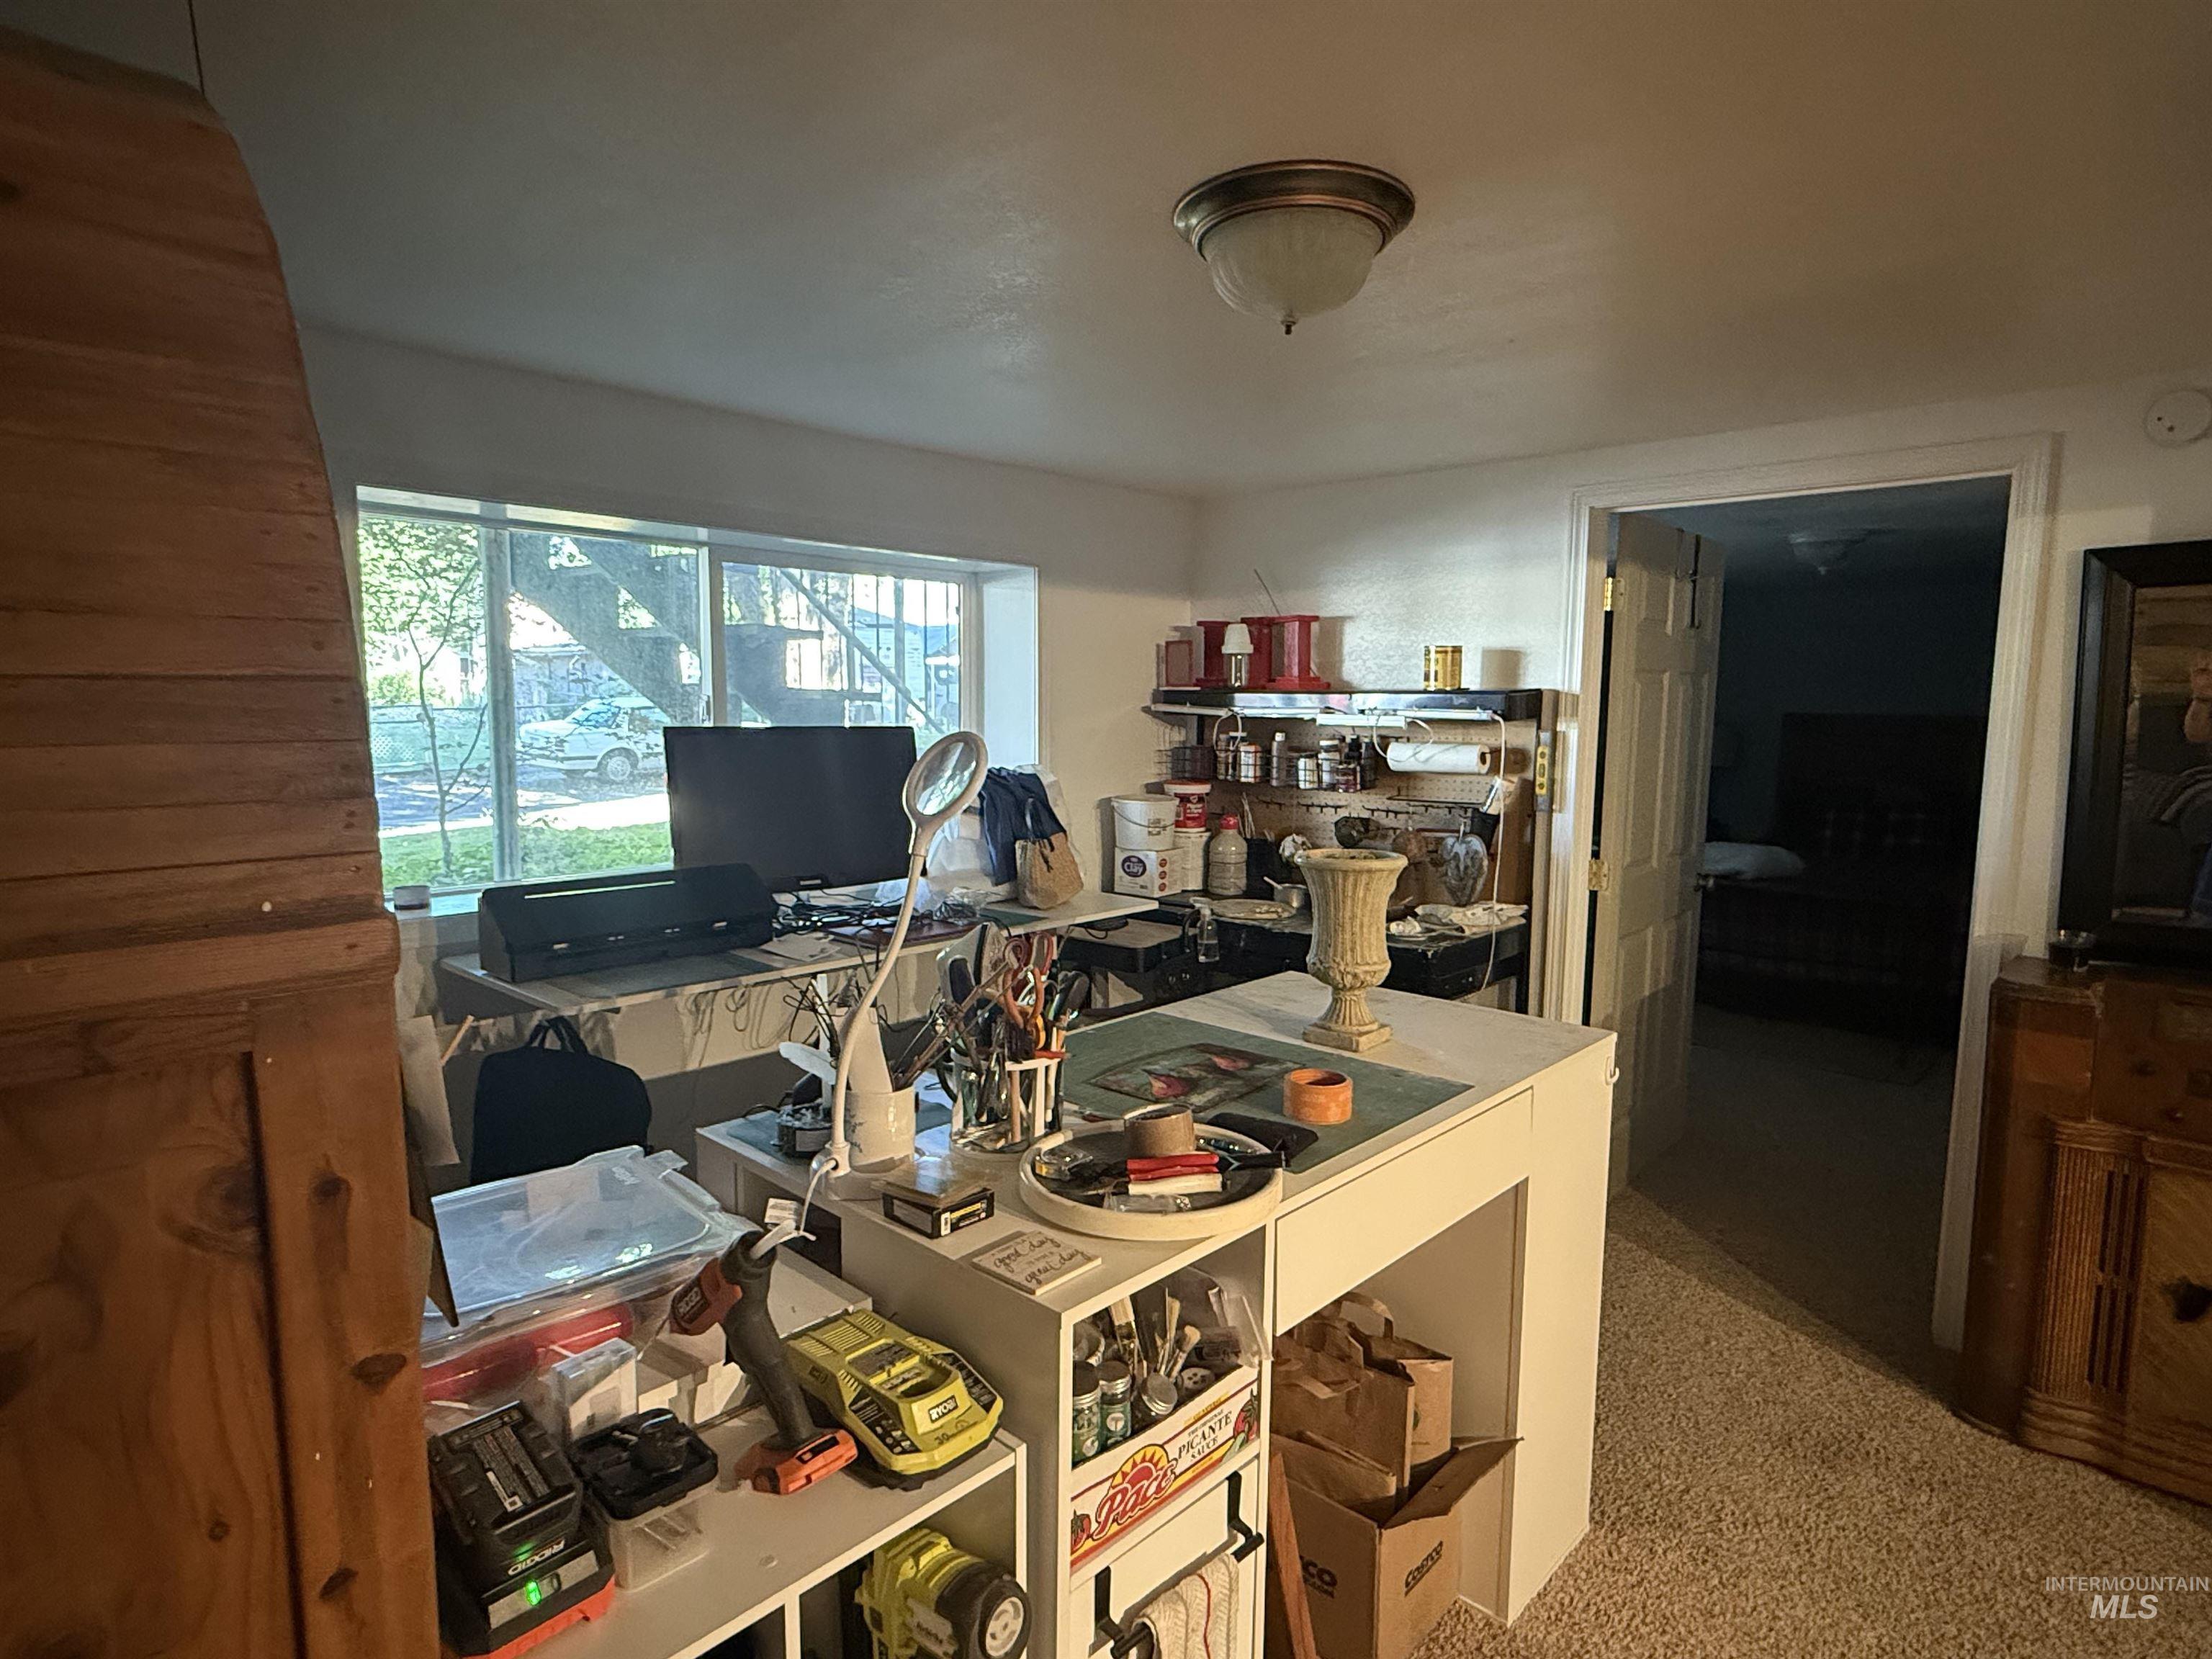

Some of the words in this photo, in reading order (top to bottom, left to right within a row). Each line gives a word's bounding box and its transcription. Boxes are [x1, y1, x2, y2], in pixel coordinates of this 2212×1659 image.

[1124, 862, 1143, 876] Clay
[994, 1247, 1023, 1273] good
[1028, 1236, 1061, 1250] day
[1025, 1261, 1056, 1285] great
[1058, 1248, 1092, 1265] day
[929, 1398, 957, 1421] RYOBI
[1178, 1411, 1233, 1460] PICANTE
[1190, 1435, 1219, 1460] SAUCE
[1094, 1460, 1177, 1540] Pace
